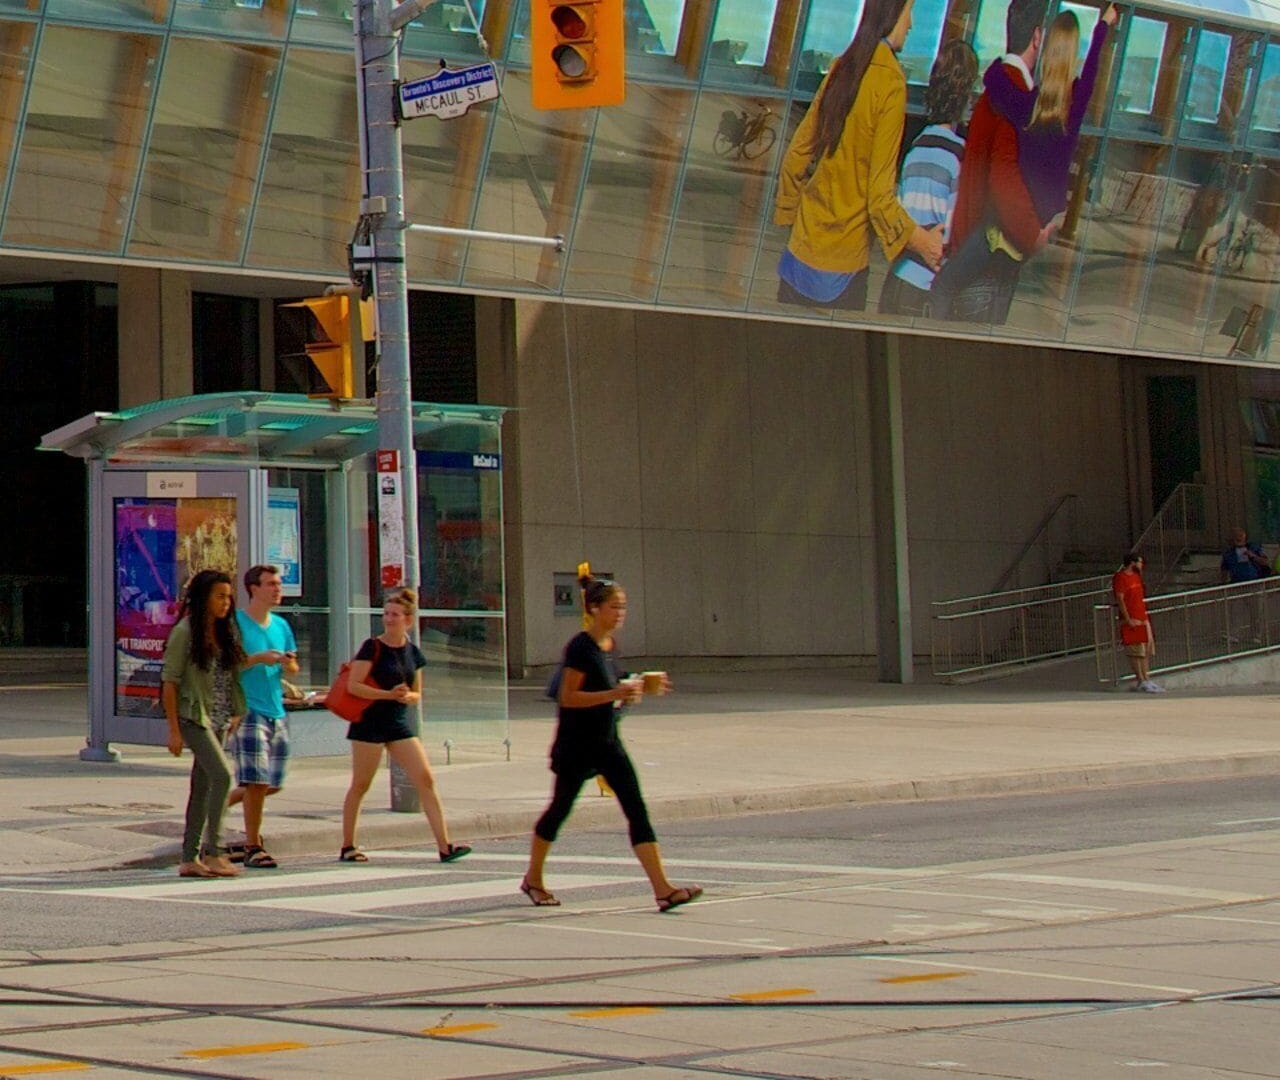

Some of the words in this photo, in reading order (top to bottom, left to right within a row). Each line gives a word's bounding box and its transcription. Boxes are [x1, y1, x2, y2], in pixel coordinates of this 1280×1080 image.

[403, 83, 431, 97] Toronto's
[432, 76, 465, 91] Discovery
[467, 69, 494, 82] District
